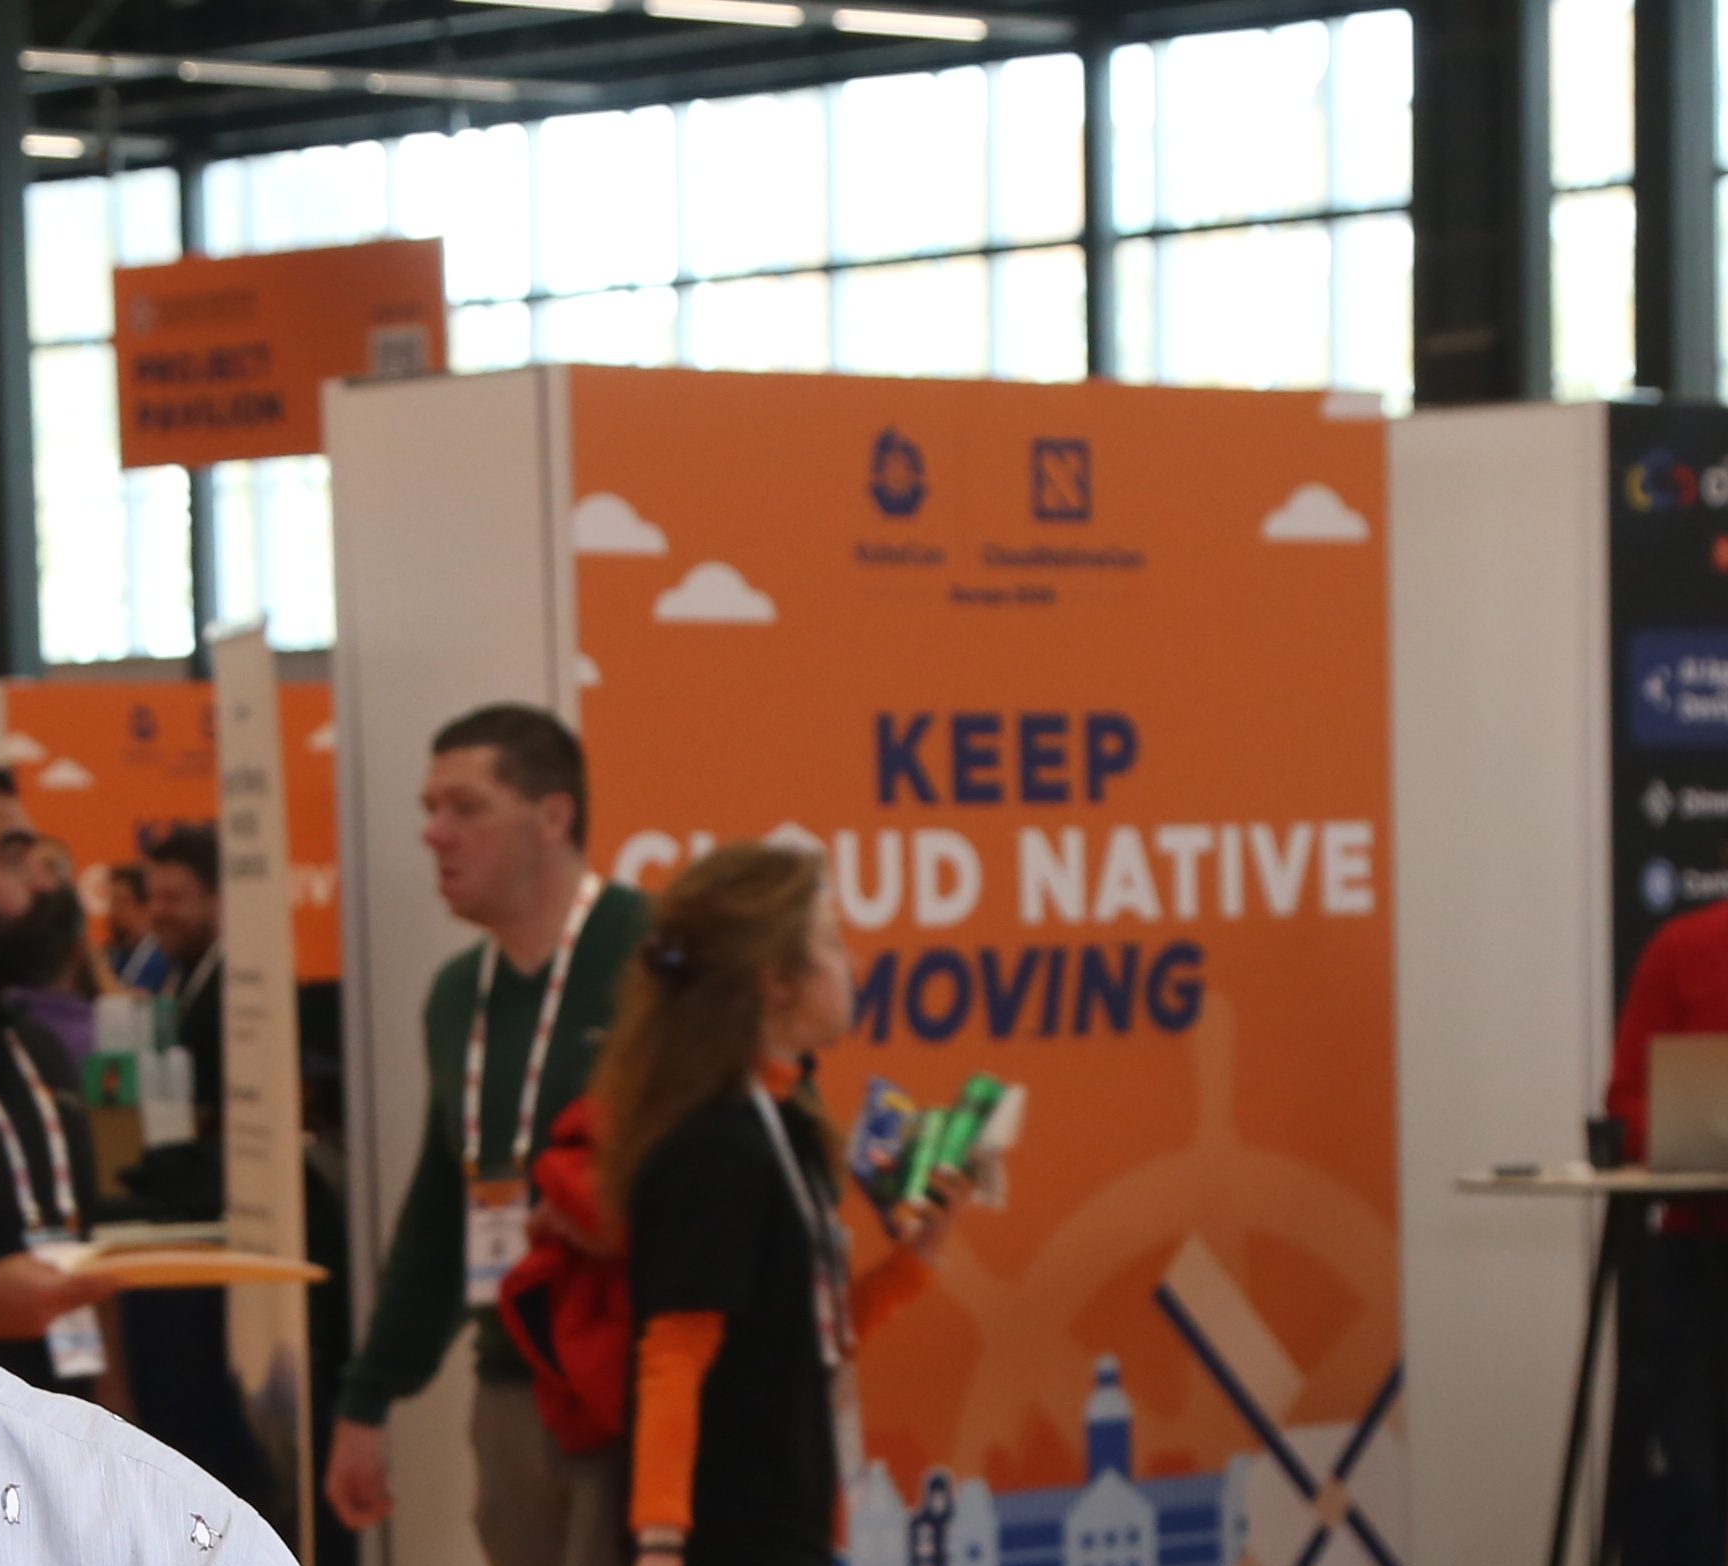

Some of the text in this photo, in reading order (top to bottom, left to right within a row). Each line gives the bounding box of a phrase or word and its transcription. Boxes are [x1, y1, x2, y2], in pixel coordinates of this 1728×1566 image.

[133, 341, 271, 384] PROJECT
[135, 393, 284, 433] PAVILION
[875, 710, 1139, 806] KEEP
[612, 819, 1375, 929] CUD NATIVE
[850, 940, 1206, 1046] MOVING
